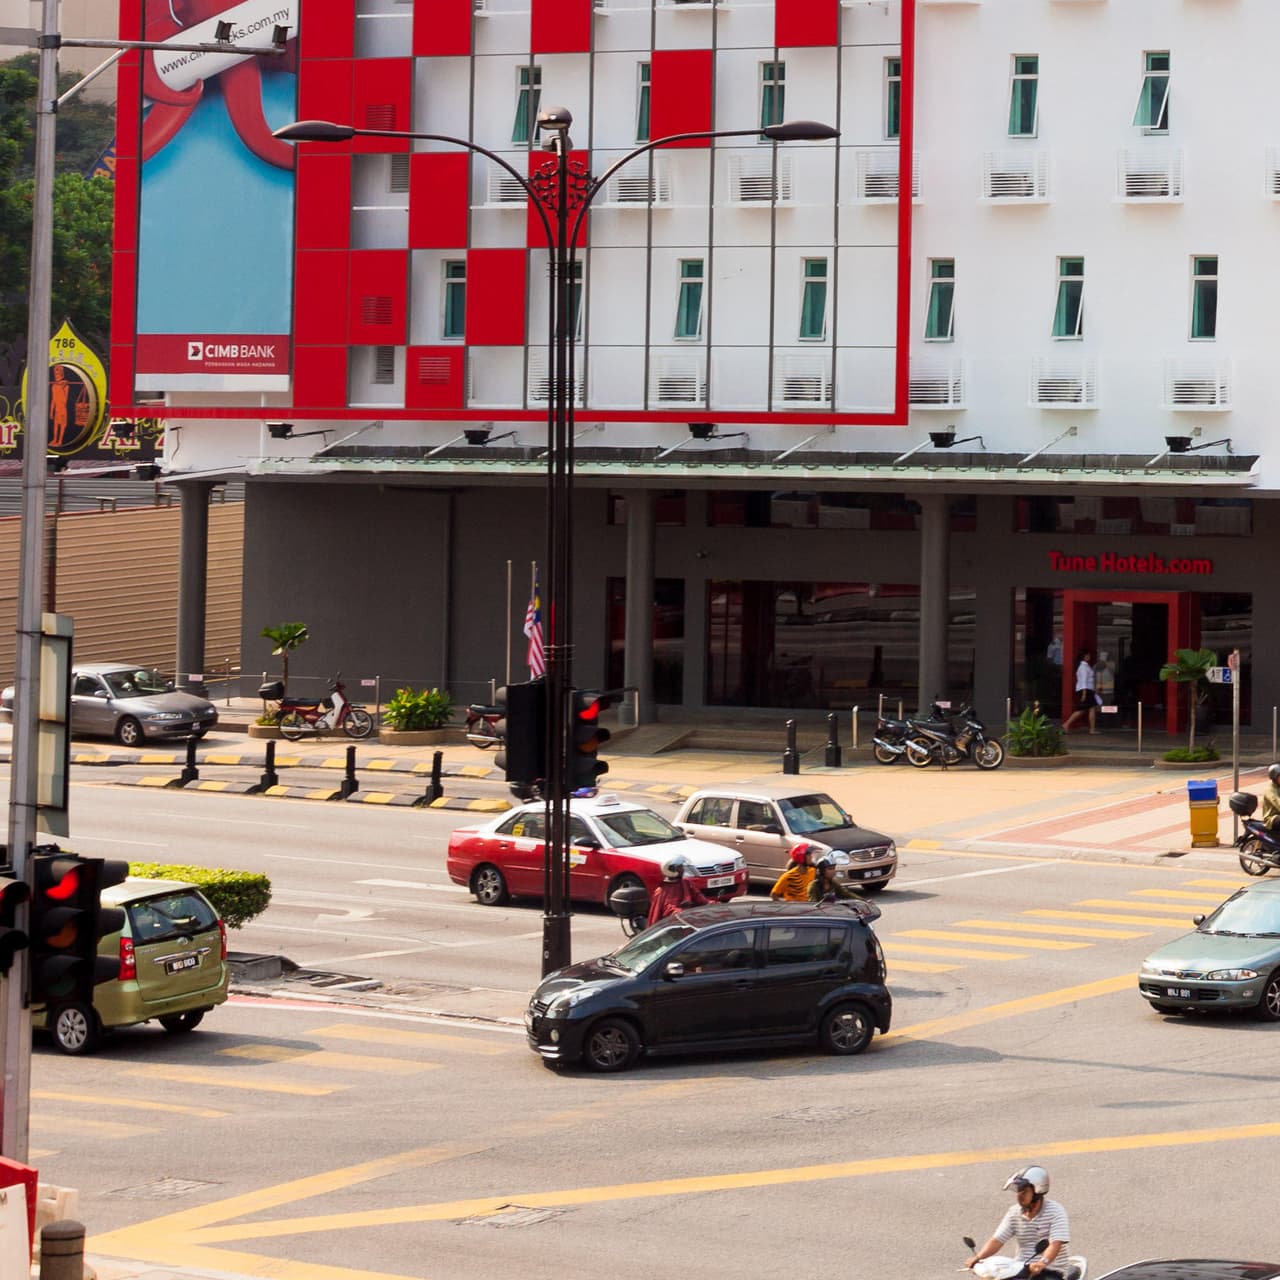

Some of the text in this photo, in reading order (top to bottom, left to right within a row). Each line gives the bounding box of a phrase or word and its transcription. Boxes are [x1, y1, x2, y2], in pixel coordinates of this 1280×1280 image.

[55, 339, 76, 349] 786
[205, 344, 275, 359] CIMB BANK
[1048, 551, 1213, 575] Tune Hotels.com
